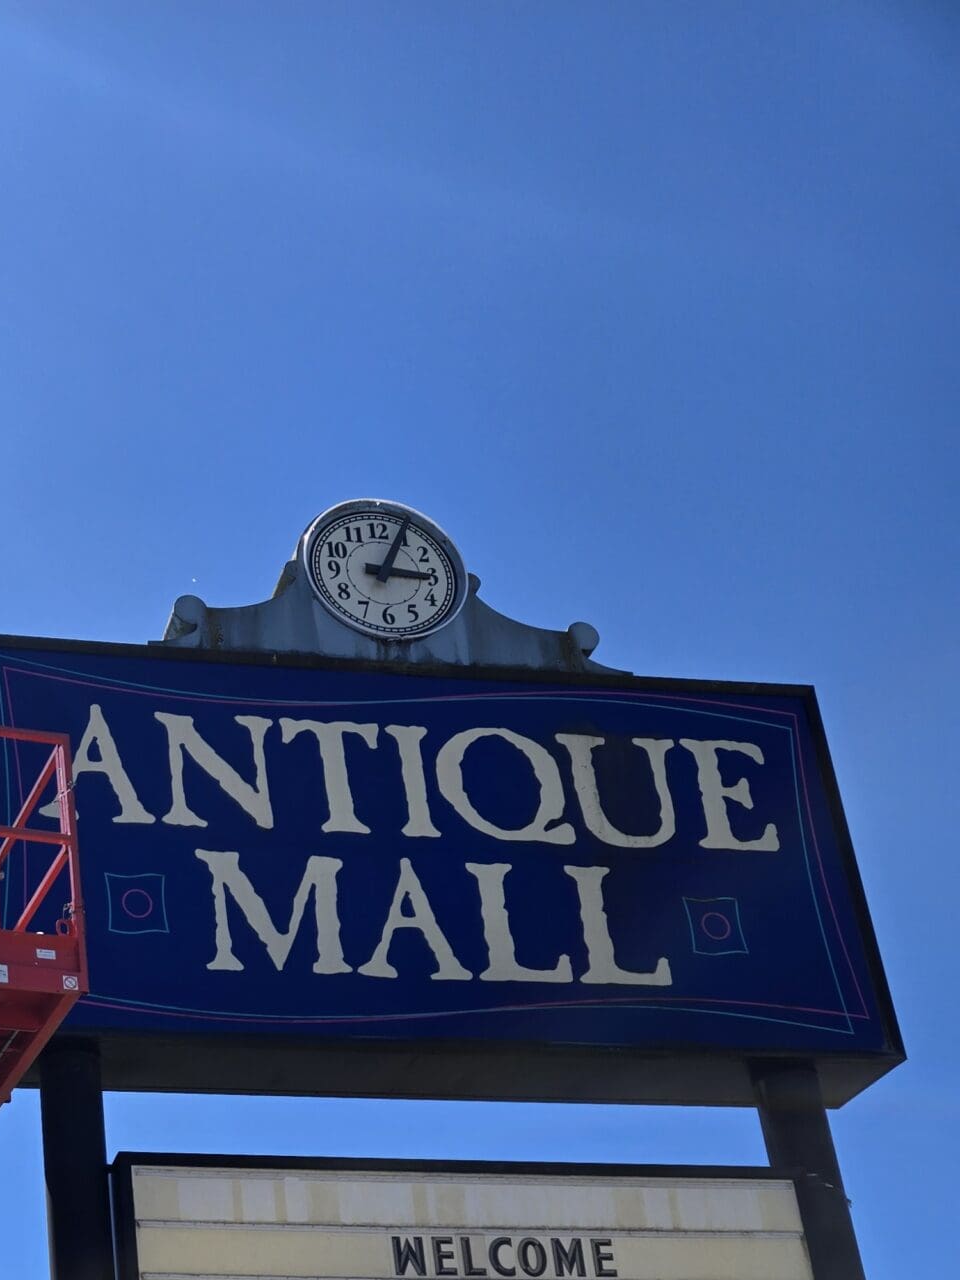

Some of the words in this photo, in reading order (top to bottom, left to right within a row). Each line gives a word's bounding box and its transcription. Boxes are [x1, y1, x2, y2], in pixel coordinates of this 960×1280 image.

[342, 526, 363, 543] 11
[367, 523, 389, 540] 12
[326, 541, 348, 559] 10
[417, 546, 429, 563] 2
[327, 560, 340, 579] 9
[426, 567, 439, 587] 3
[337, 583, 351, 600] 8
[424, 588, 438, 607] 4
[358, 600, 370, 619] 7
[382, 606, 396, 625] 6
[407, 604, 419, 623] 5
[38, 703, 780, 852] ANTIQUE
[194, 849, 672, 987] MALL
[391, 1235, 619, 1278] WELCOME
